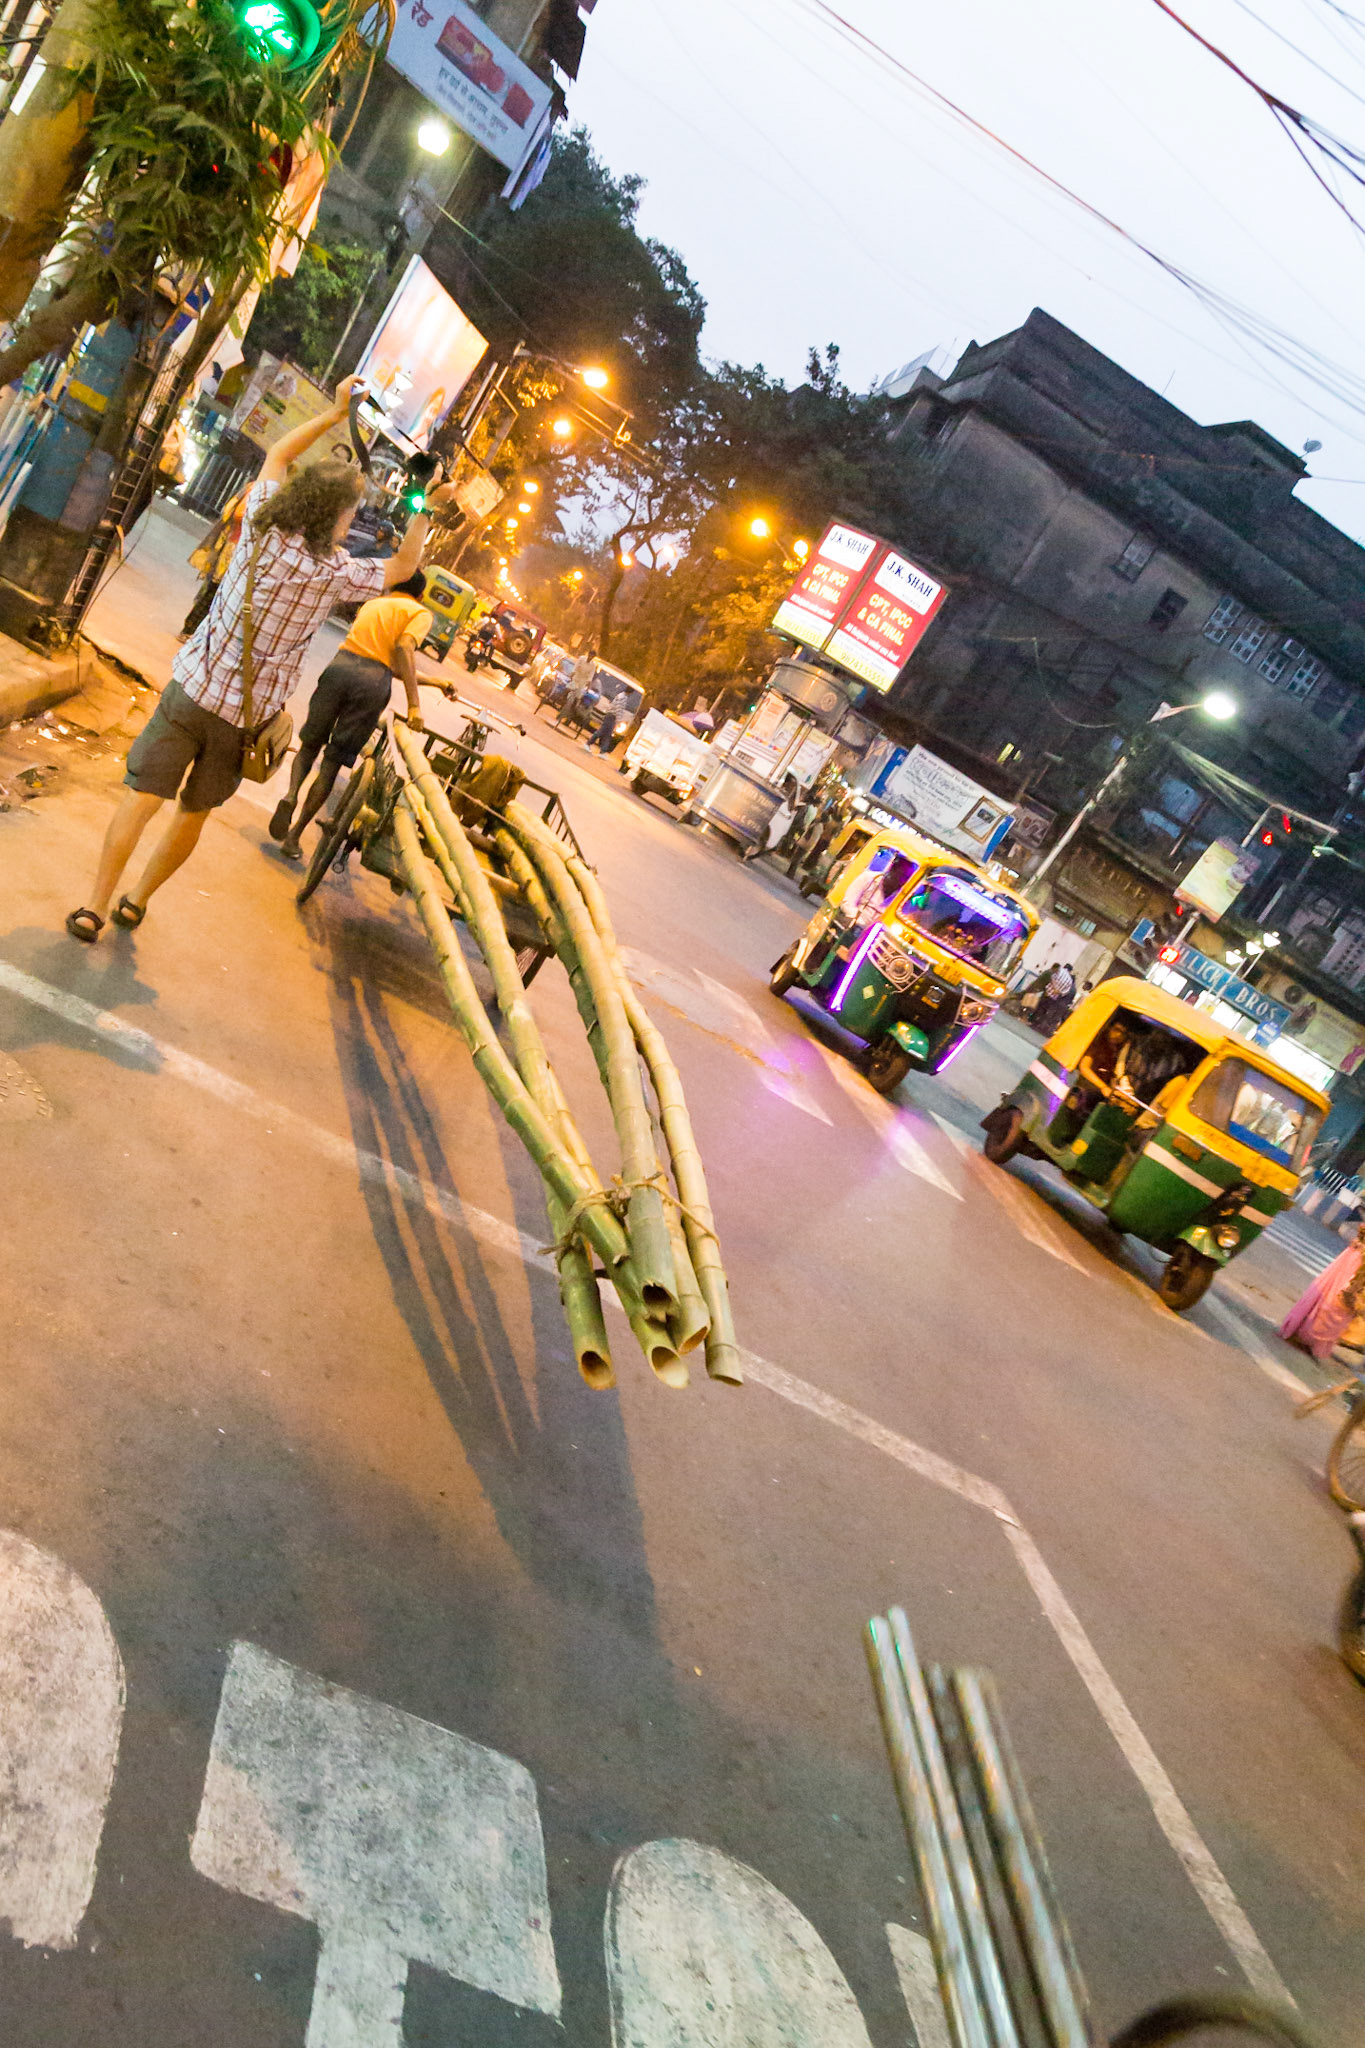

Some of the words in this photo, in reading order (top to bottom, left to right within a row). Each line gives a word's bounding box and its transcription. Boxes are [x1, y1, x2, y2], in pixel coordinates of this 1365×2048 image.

[830, 532, 844, 548] J.K.
[847, 537, 869, 555] SHAH
[802, 578, 809, 589] &
[810, 580, 822, 596] CA
[821, 584, 841, 605] FINAL
[812, 563, 830, 581] CPT,
[829, 570, 849, 588] IPCC
[887, 561, 903, 579] J.K.
[907, 573, 934, 598] SHAH
[857, 608, 868, 621] &
[866, 613, 881, 630] CA
[878, 620, 904, 646] FINAL
[869, 593, 890, 616] CPT,
[890, 606, 913, 629] IPCC
[1235, 986, 1279, 1022] BROS
